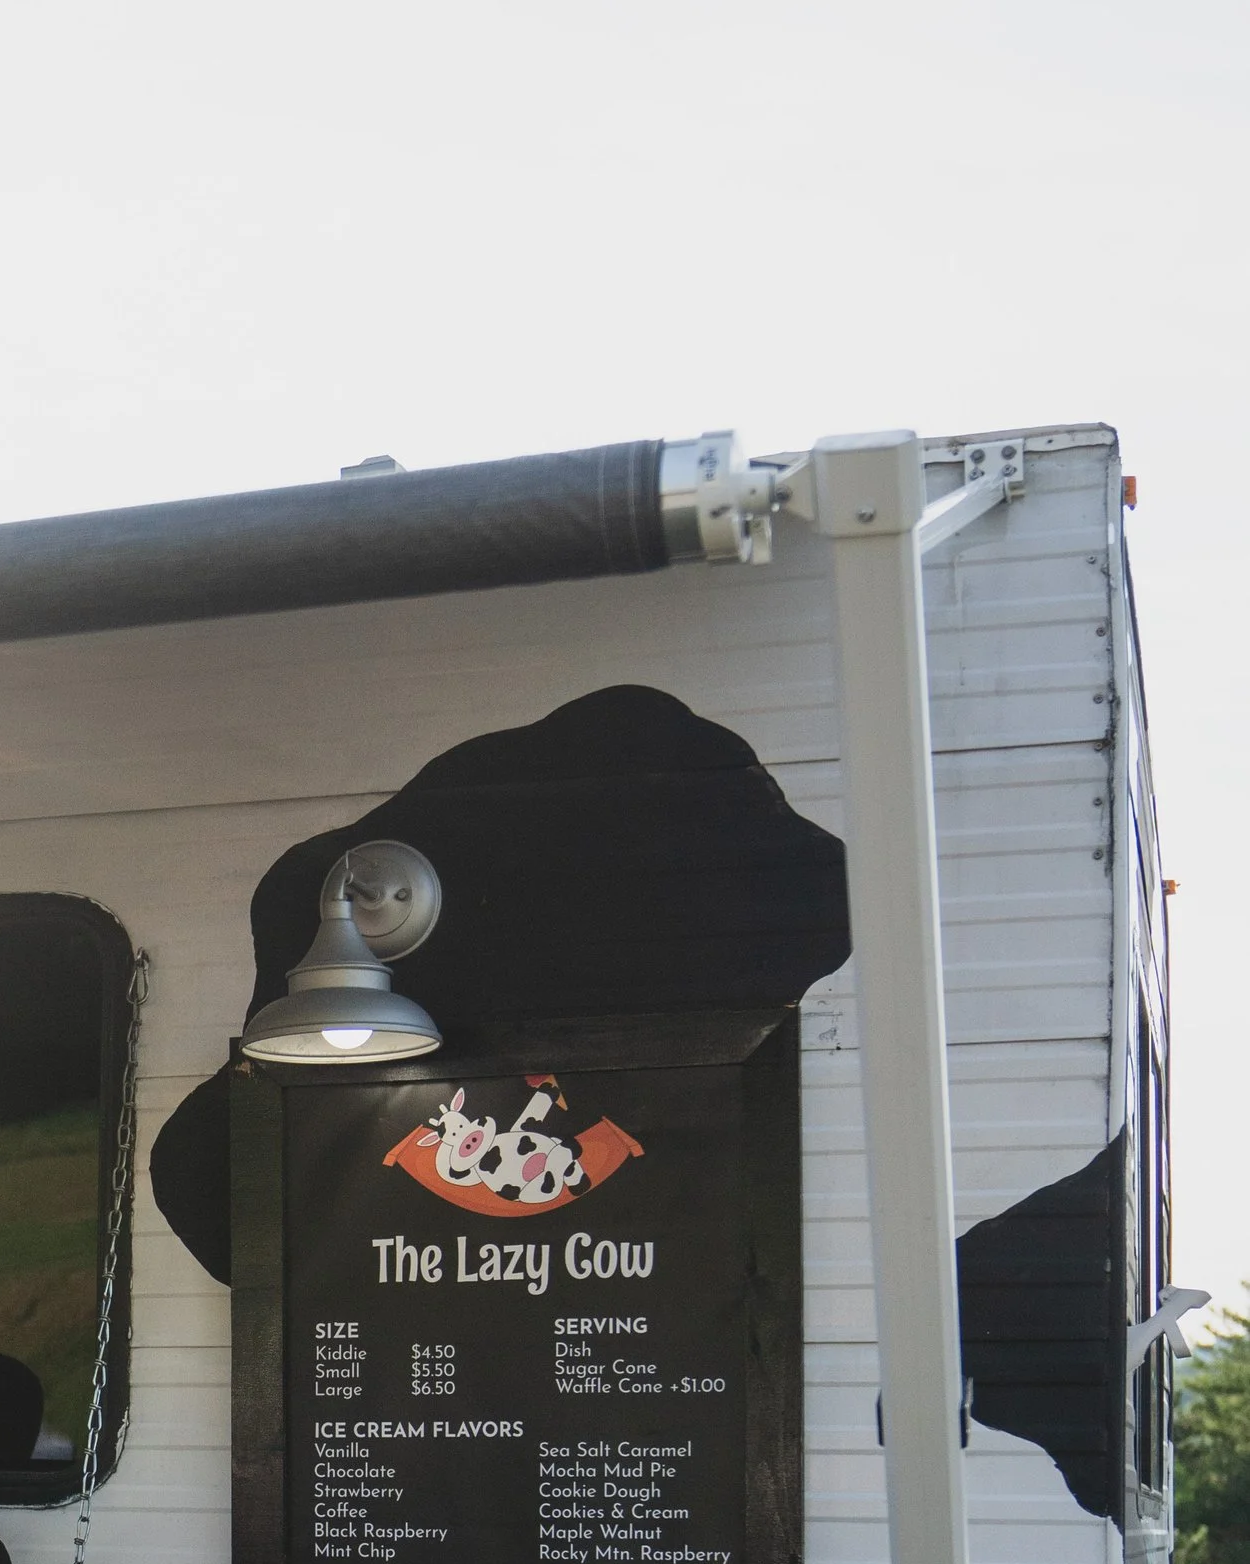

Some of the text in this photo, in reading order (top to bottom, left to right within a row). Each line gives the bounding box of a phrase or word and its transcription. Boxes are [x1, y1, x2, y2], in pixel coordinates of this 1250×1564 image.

[371, 1231, 655, 1296] The Lazy Cow
[314, 1321, 360, 1340] SIZE
[553, 1316, 648, 1336] SERVING
[315, 1342, 456, 1361] Kiddie $4.50
[555, 1340, 592, 1358] Dish
[315, 1360, 456, 1379] Small $5.50
[554, 1358, 658, 1379] Sugar Cone
[315, 1378, 456, 1400] Large $6.50
[554, 1376, 726, 1394] Waffle Cone +$1.00
[314, 1420, 524, 1439] ICE CREAM FLAVORS
[314, 1441, 370, 1459] Vanilla
[538, 1440, 692, 1458] Sea Salt Caramel
[314, 1461, 396, 1479] Chocolate
[539, 1460, 677, 1478] Mocha Mud Pie
[313, 1481, 404, 1502] Strawberry
[538, 1480, 661, 1502] Cookie Dough
[314, 1501, 368, 1519] Coffee
[538, 1501, 689, 1520] Cookies & Cream
[314, 1521, 448, 1543] Black Raspberry
[539, 1522, 663, 1543] Maple Walnut
[314, 1541, 396, 1562] Mint Chip
[539, 1543, 589, 1564] Rocky
[595, 1544, 635, 1561] Mtn.
